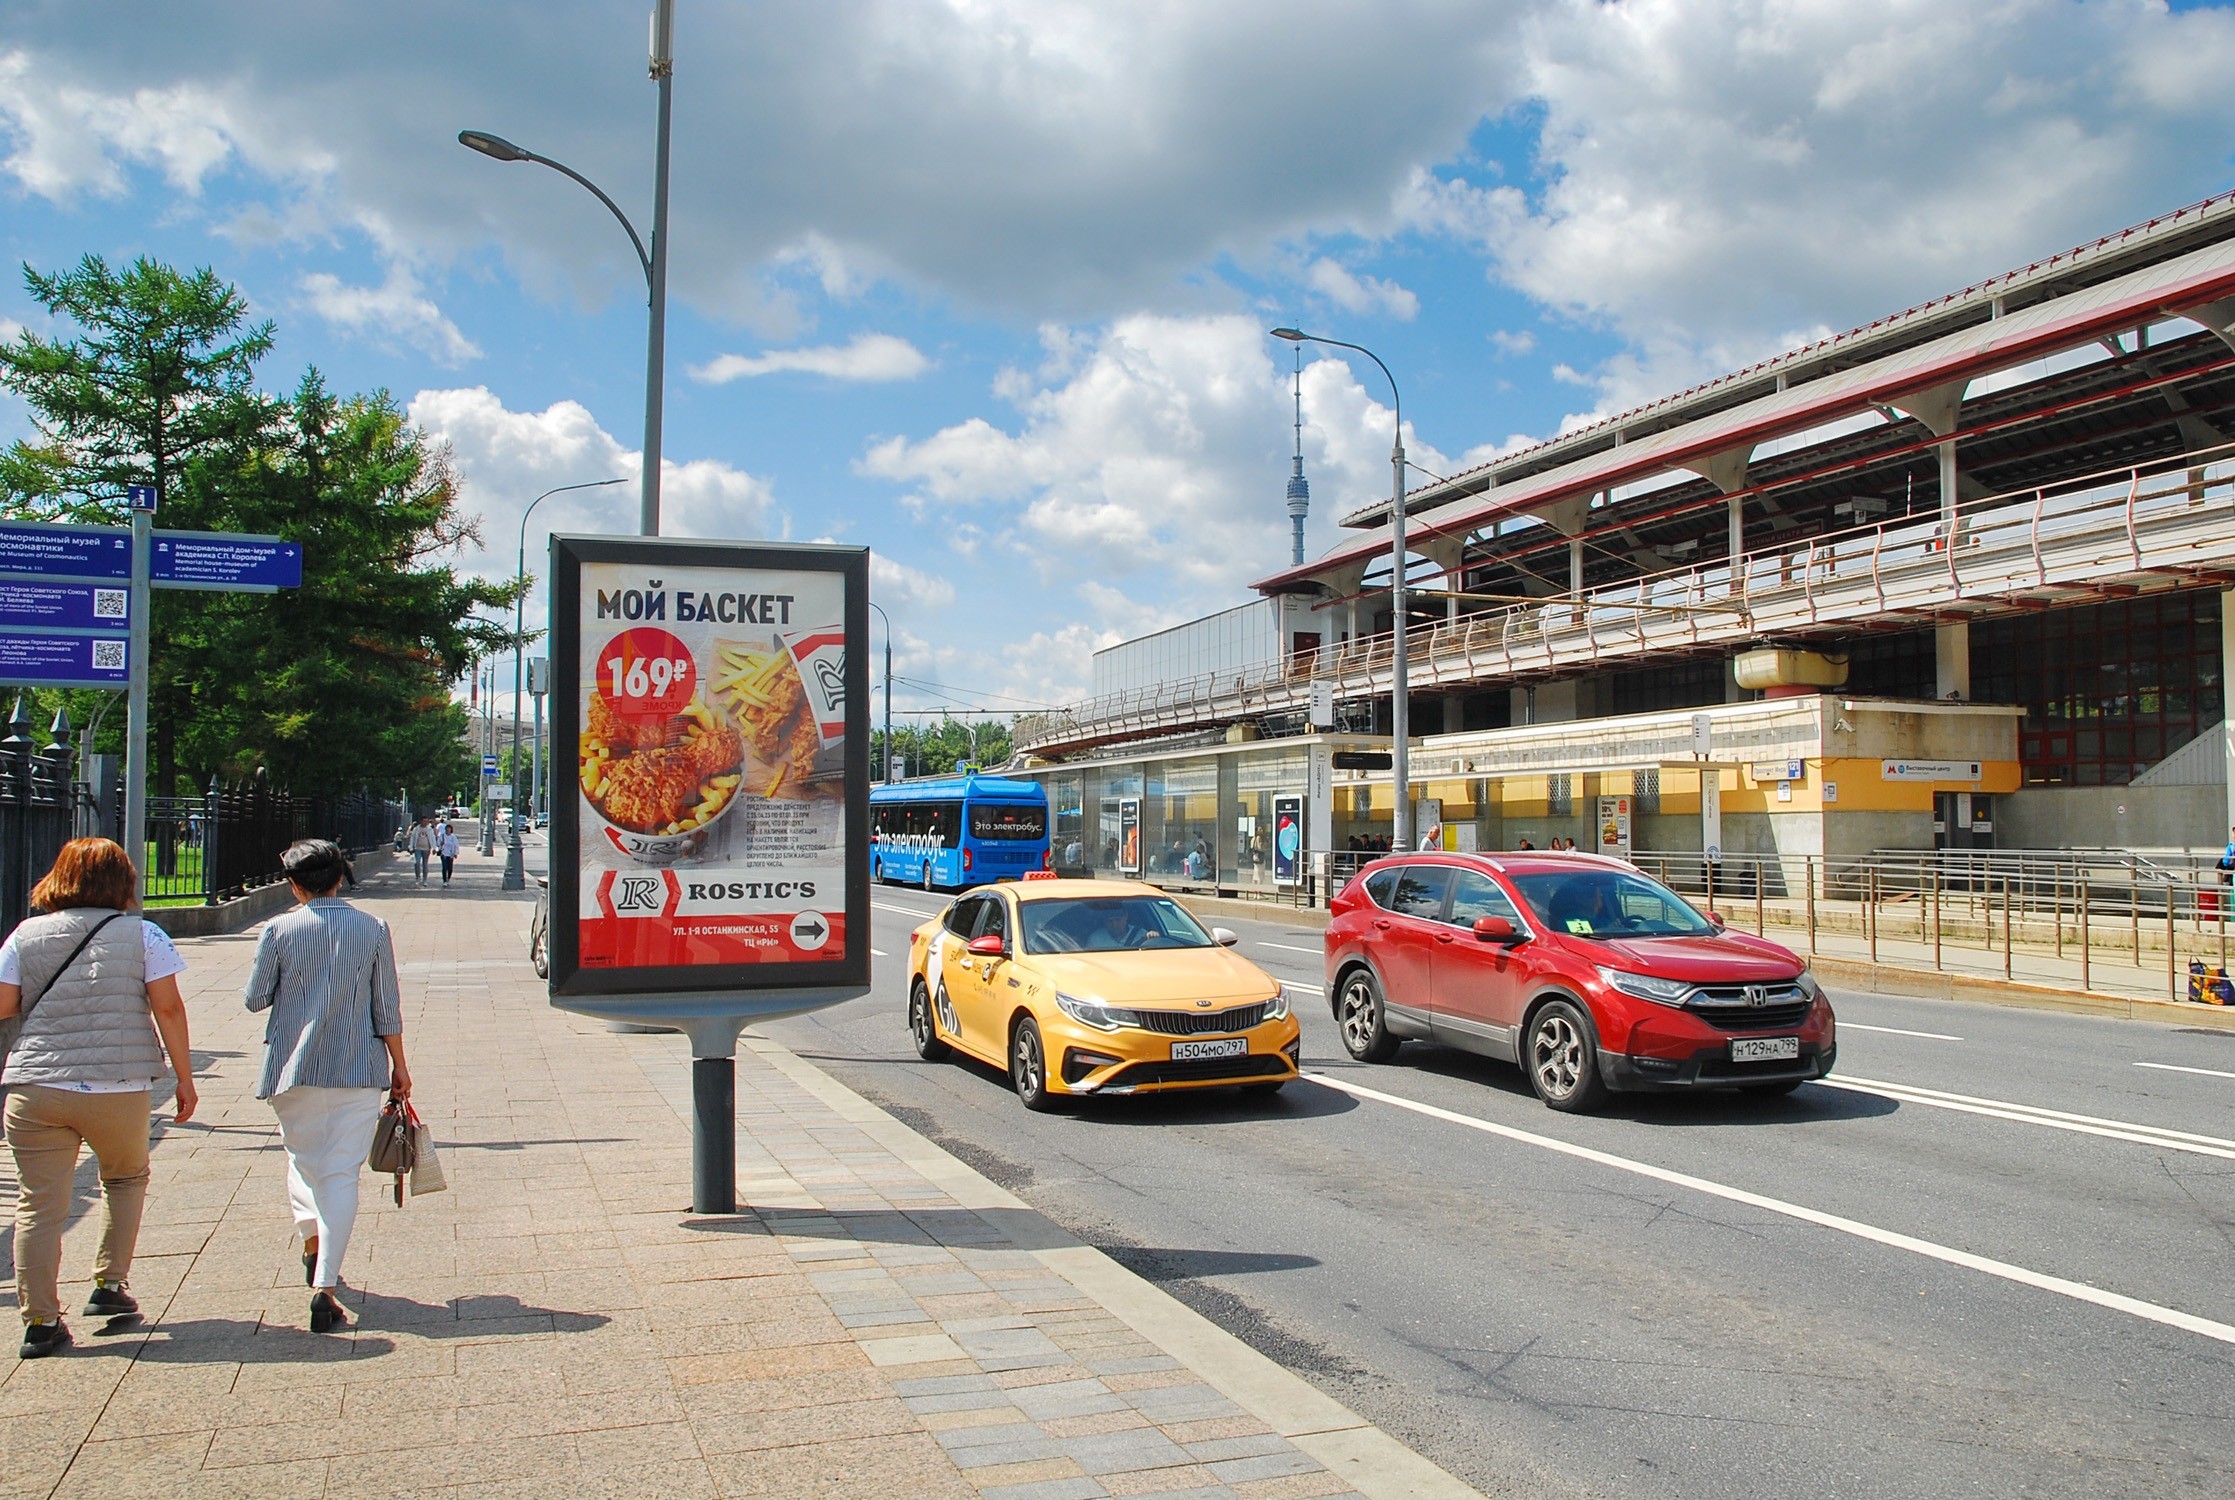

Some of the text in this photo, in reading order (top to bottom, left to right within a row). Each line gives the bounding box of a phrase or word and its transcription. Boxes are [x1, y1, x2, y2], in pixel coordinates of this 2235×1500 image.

[0, 542, 64, 552] осмонавтики
[72, 538, 100, 546] музей
[175, 544, 276, 556] Мемориальный дом-музей
[44, 552, 88, 561] Cosmonautics
[175, 552, 216, 560] академика
[232, 554, 267, 562] Королева
[204, 560, 250, 568] house-museum
[175, 566, 212, 574] academician
[10, 586, 30, 594] Героя
[597, 579, 795, 625] МОЙ БАСКЕТ
[1788, 761, 1799, 770] 121
[1906, 764, 1936, 772] Выставочный
[974, 821, 1043, 833] Это электробус.
[874, 825, 947, 864] Это электробус.
[688, 882, 816, 900] ROSTIC'S
[673, 924, 779, 936] УЛ. 1-Я ОСТАНКИНСКАЯ, 55
[744, 938, 755, 948] ТЦ
[1225, 1040, 1244, 1052] 797
[1780, 1039, 1797, 1050] 799
